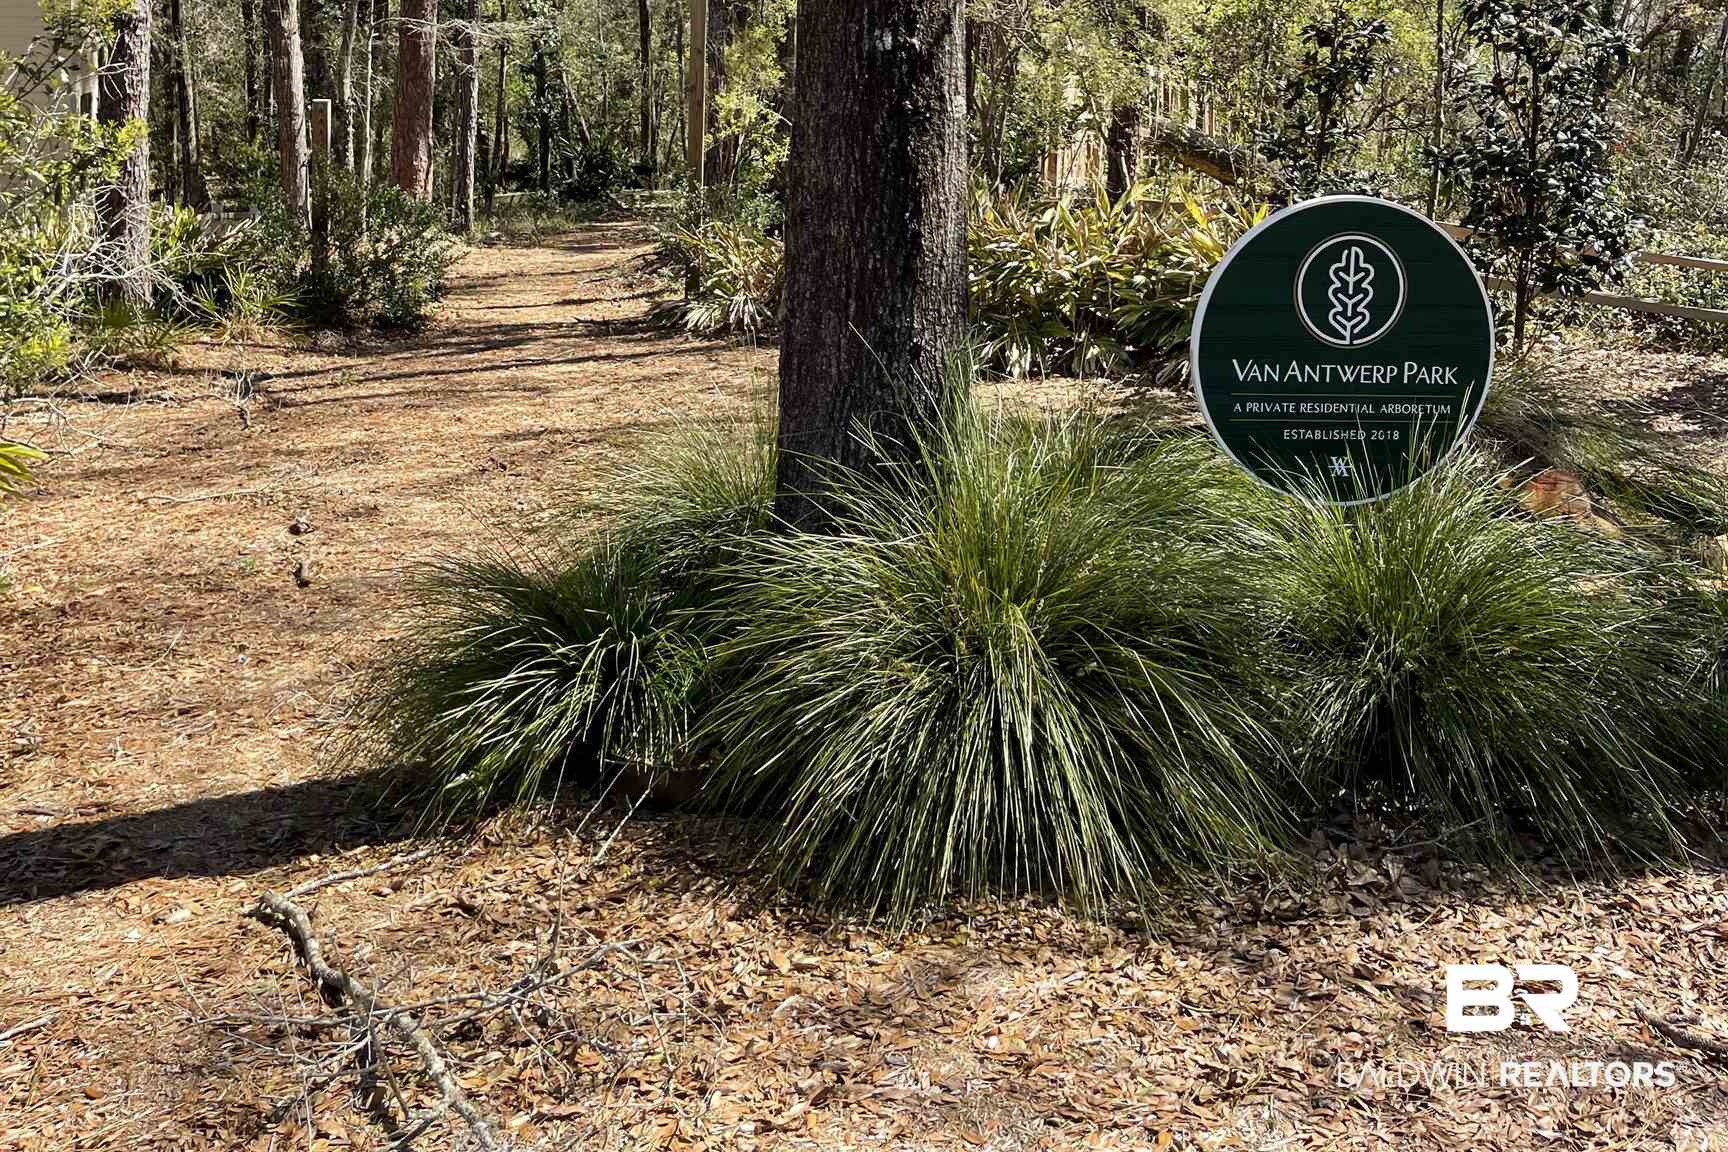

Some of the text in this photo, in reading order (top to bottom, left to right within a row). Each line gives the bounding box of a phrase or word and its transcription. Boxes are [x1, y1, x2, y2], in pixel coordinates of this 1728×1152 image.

[1283, 359, 1398, 384] ANTWERP
[1403, 361, 1459, 385] PARK
[1233, 402, 1451, 415] A PRIVATE RESIDENTIAL ARBORETUM
[1283, 429, 1400, 440] ESTABLISHED 2018
